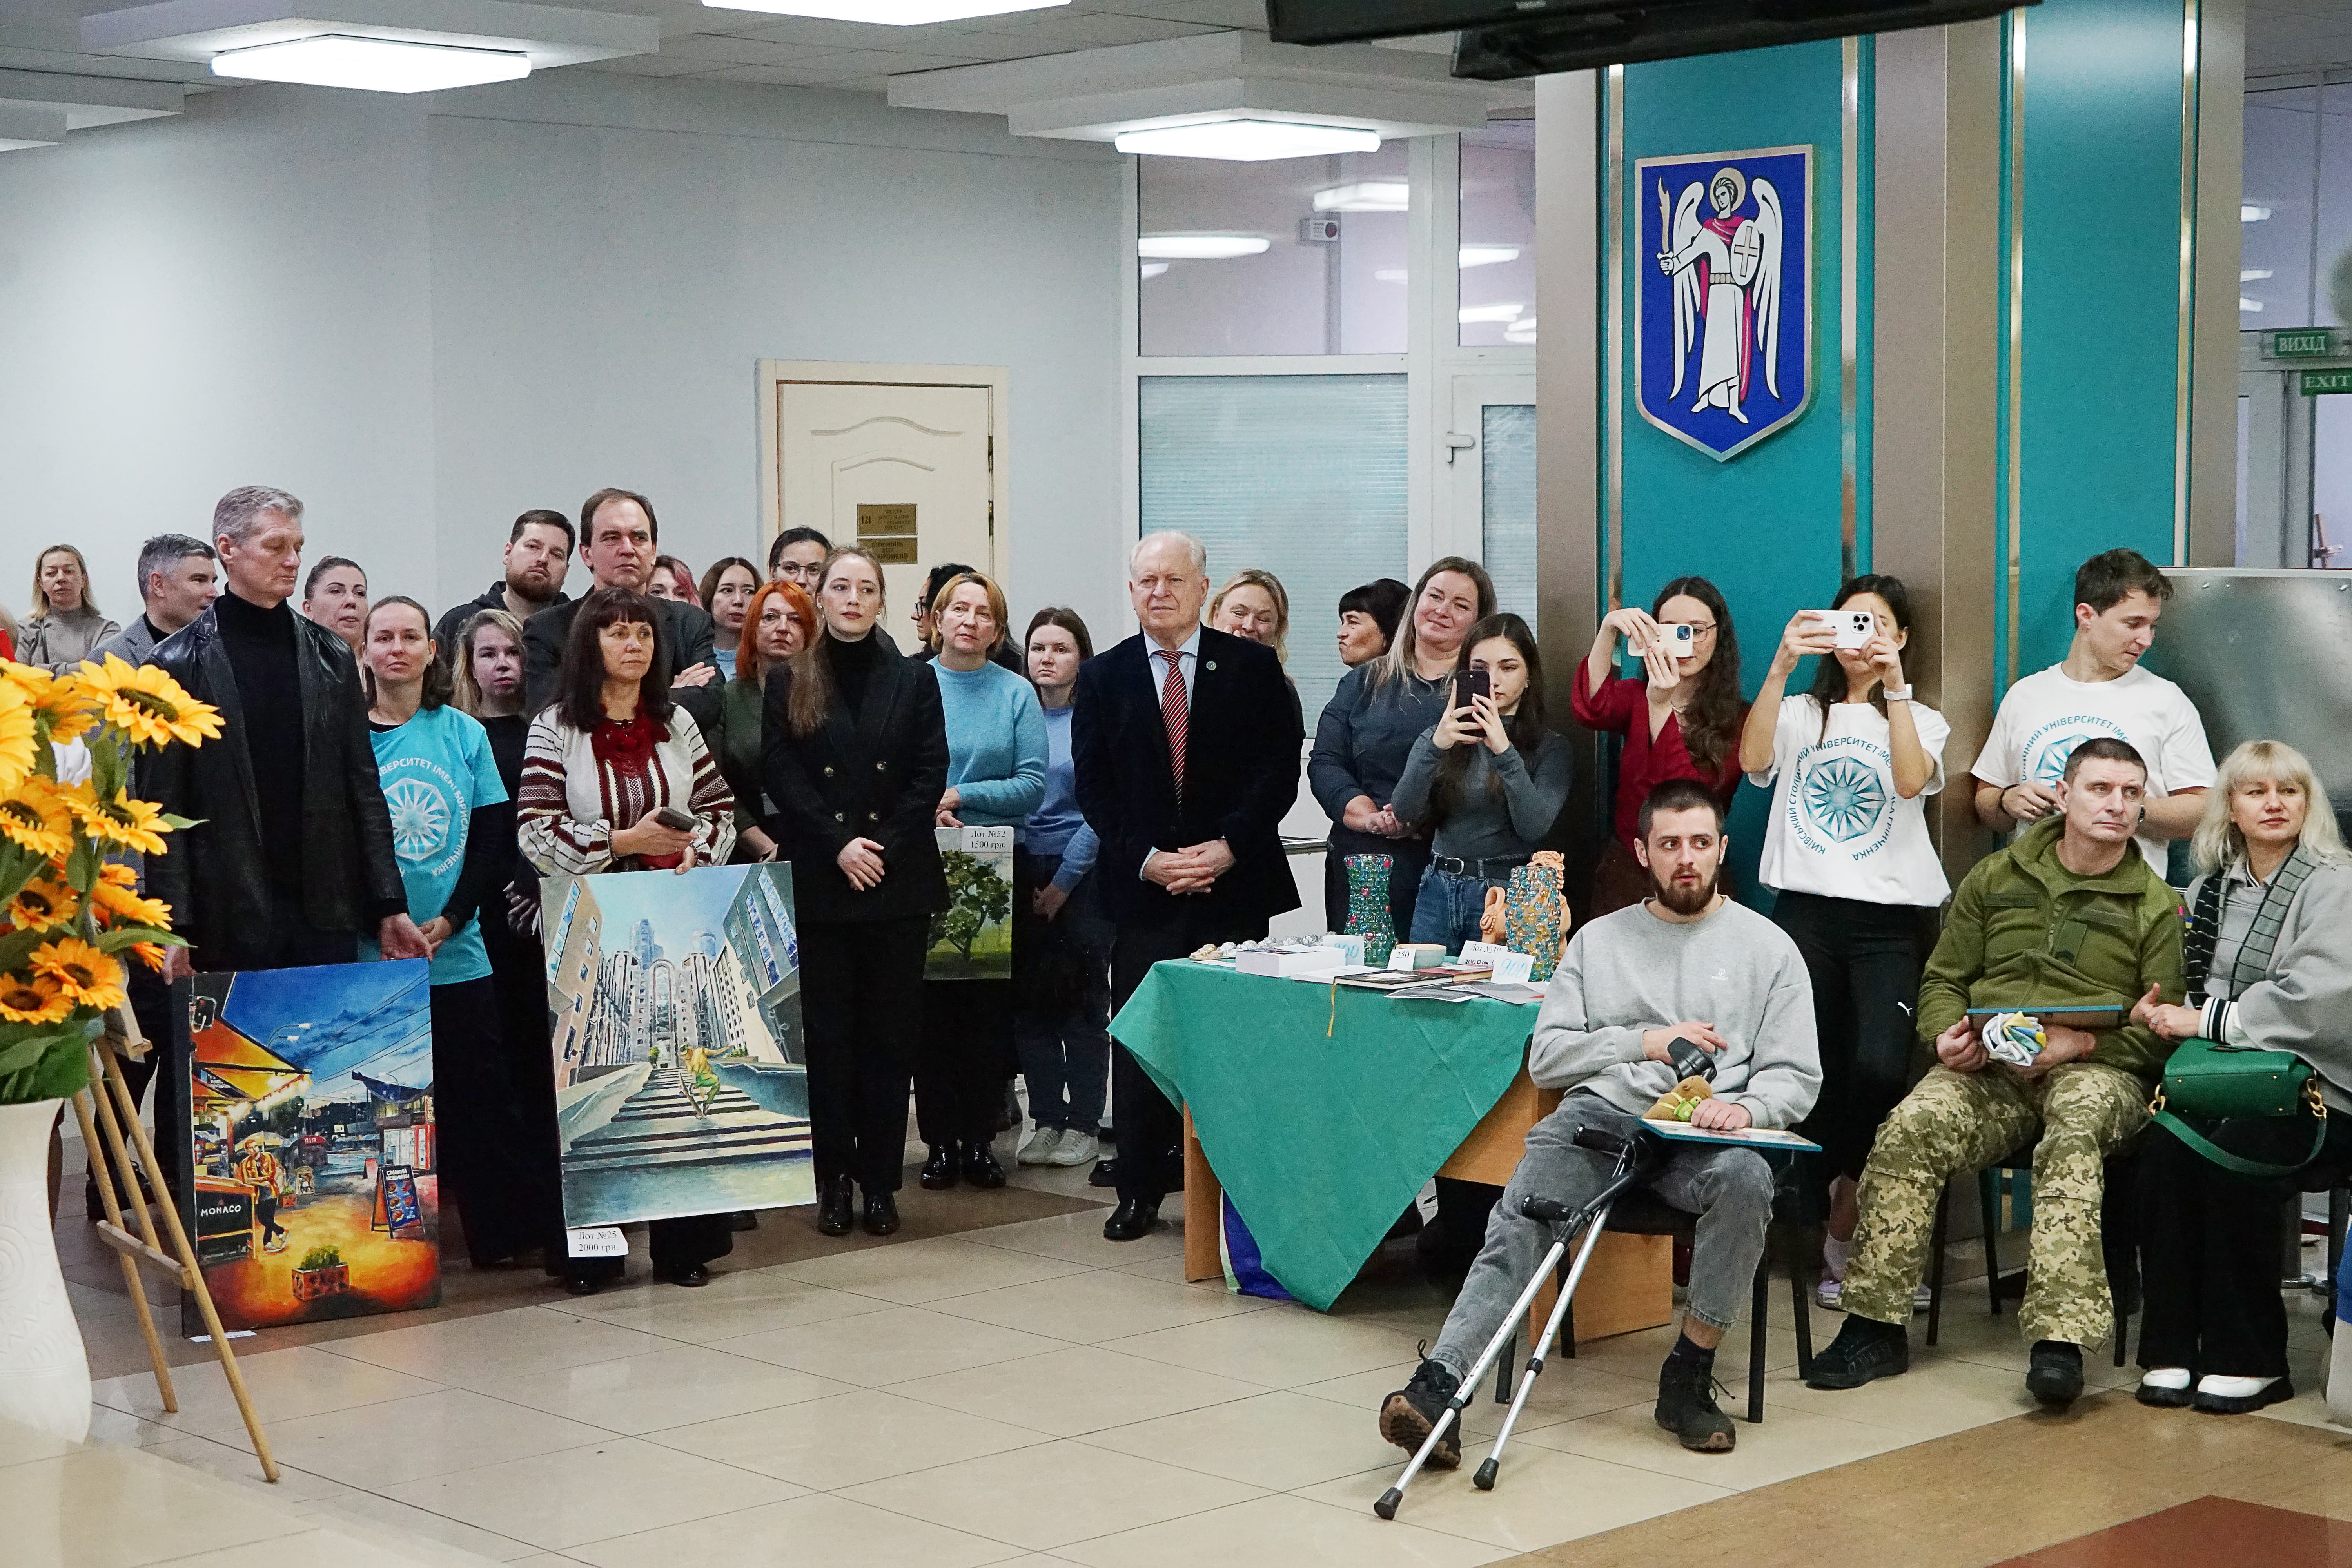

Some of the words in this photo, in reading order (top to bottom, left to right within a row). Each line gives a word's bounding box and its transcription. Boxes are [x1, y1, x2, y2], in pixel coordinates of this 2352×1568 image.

[2278, 336, 2326, 352] ВИХІД
[2305, 375, 2352, 388] EXIT
[2043, 716, 2113, 732] УНІВЕРСИТЕТ
[2112, 726, 2130, 744] ІМЕ
[1878, 750, 1892, 768] ІМЕ
[379, 757, 432, 777] ВЕРСИТЕТ
[433, 764, 457, 790] ІМЕНІ
[454, 790, 468, 830] БОРИСА
[1787, 808, 1826, 855] КИЇВСЬКИЙ
[1852, 817, 1893, 861] ГРІНЧЕНКА
[1470, 944, 1483, 952] Лот
[1498, 958, 1528, 978] 900
[201, 1205, 241, 1216] MONACO
[597, 1231, 617, 1239] №25
